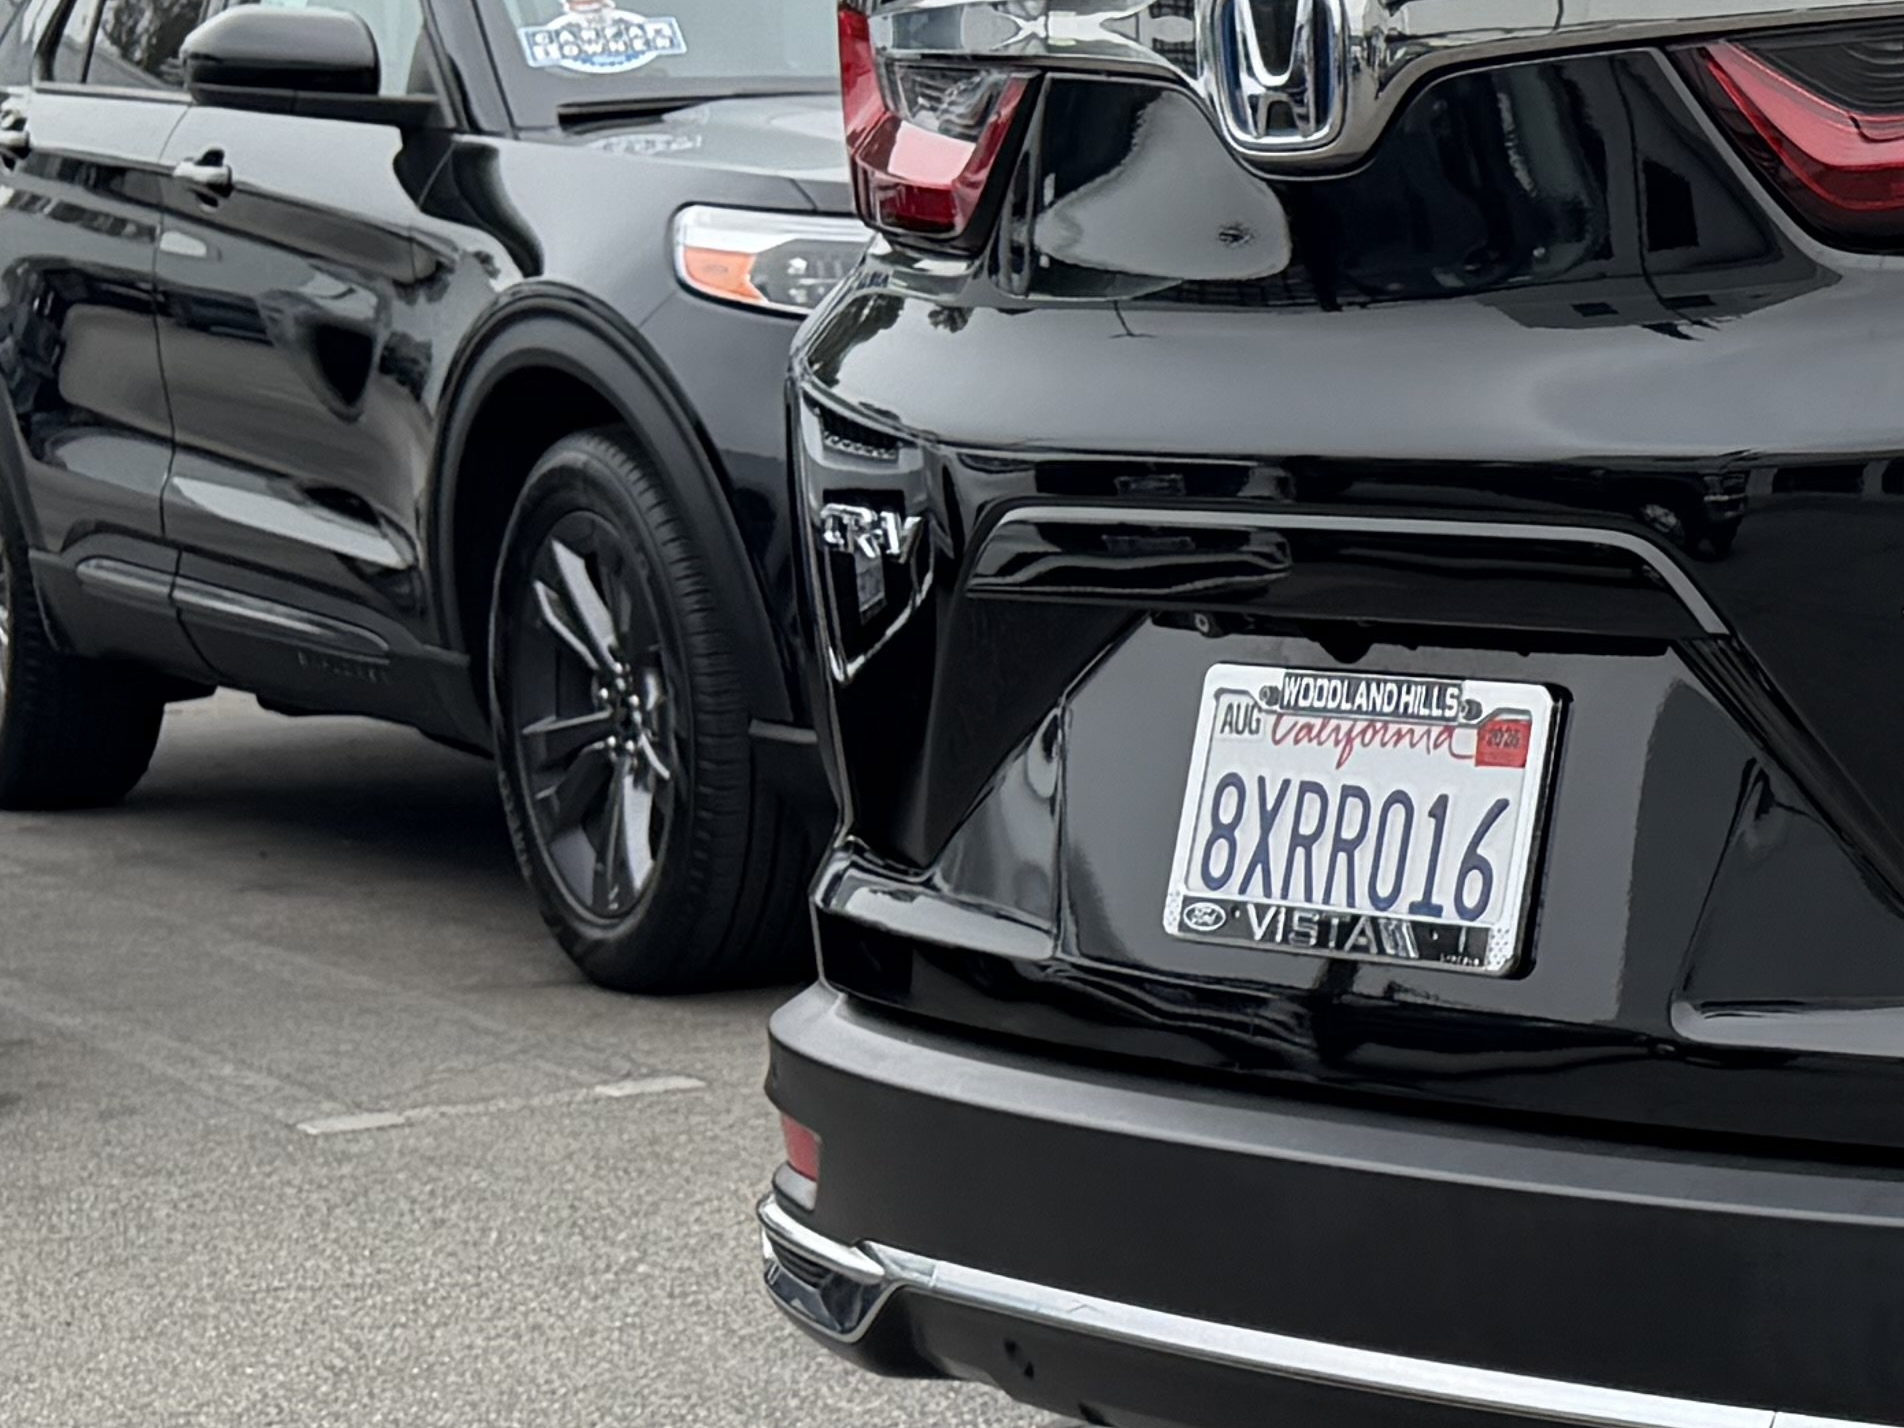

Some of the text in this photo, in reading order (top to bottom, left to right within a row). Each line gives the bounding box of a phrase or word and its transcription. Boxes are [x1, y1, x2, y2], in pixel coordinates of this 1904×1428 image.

[1220, 701, 1261, 737] AUG
[1283, 674, 1461, 719] WOODLAND HILLS
[1201, 772, 1509, 922] 8XRR016
